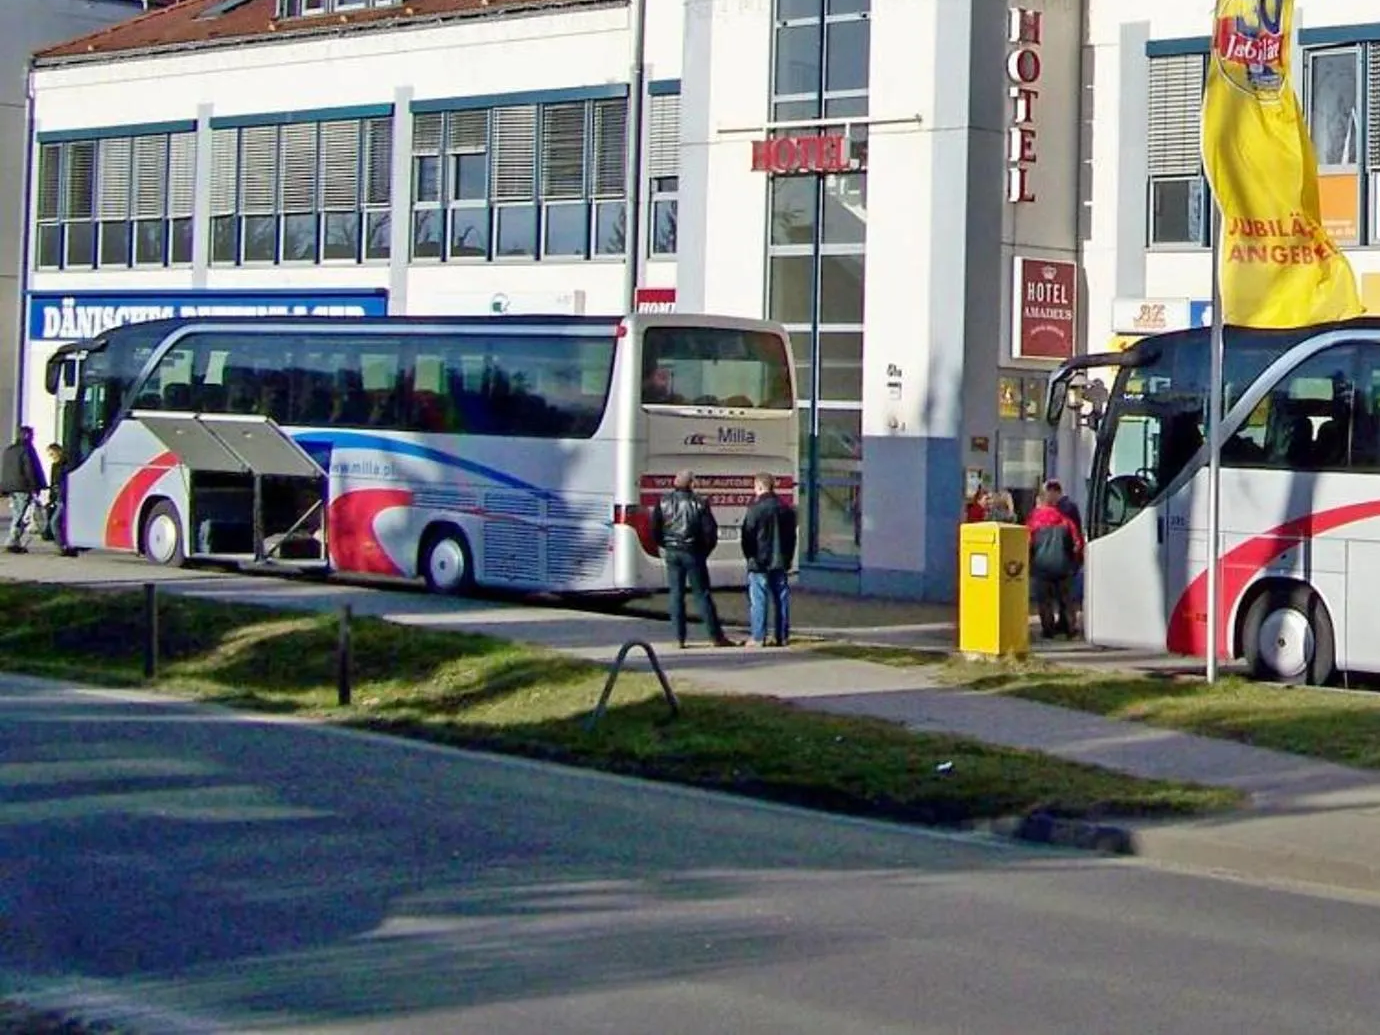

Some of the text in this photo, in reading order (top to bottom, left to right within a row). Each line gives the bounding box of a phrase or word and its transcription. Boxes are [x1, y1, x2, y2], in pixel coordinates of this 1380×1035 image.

[1006, 7, 1042, 204] HOTEL
[751, 133, 851, 173] HOTEL
[1027, 281, 1068, 304] HOTEL
